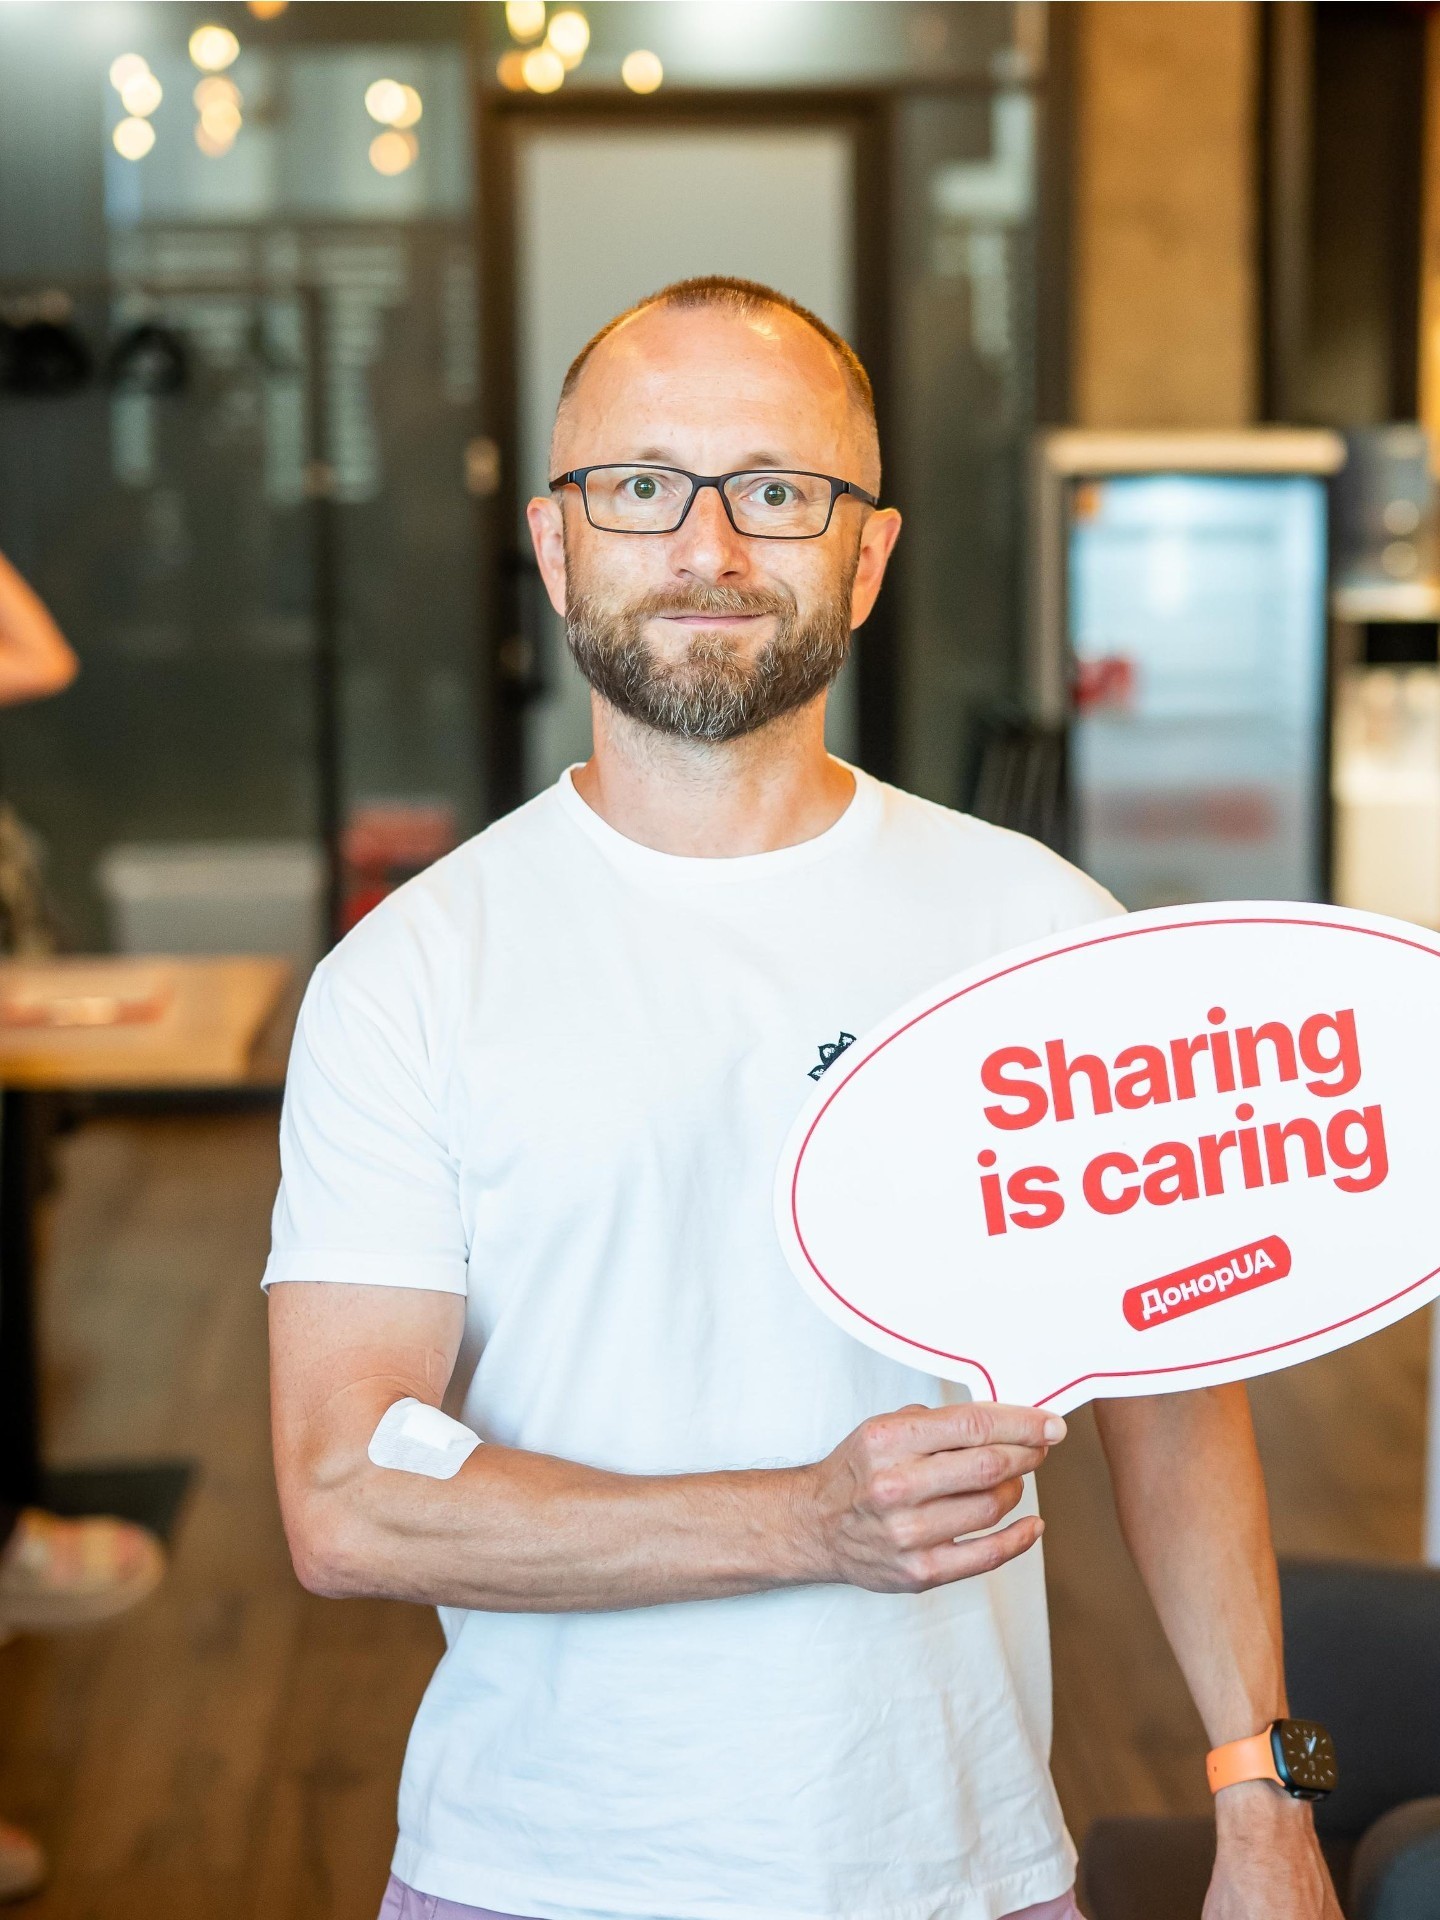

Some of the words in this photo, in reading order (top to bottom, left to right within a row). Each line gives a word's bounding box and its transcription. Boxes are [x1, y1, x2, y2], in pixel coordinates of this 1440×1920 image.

[981, 1007, 1361, 1130] Sharing
[978, 1150, 1064, 1236] is
[1083, 1104, 1389, 1214] caring
[1140, 1248, 1276, 1321] ДонорUA
